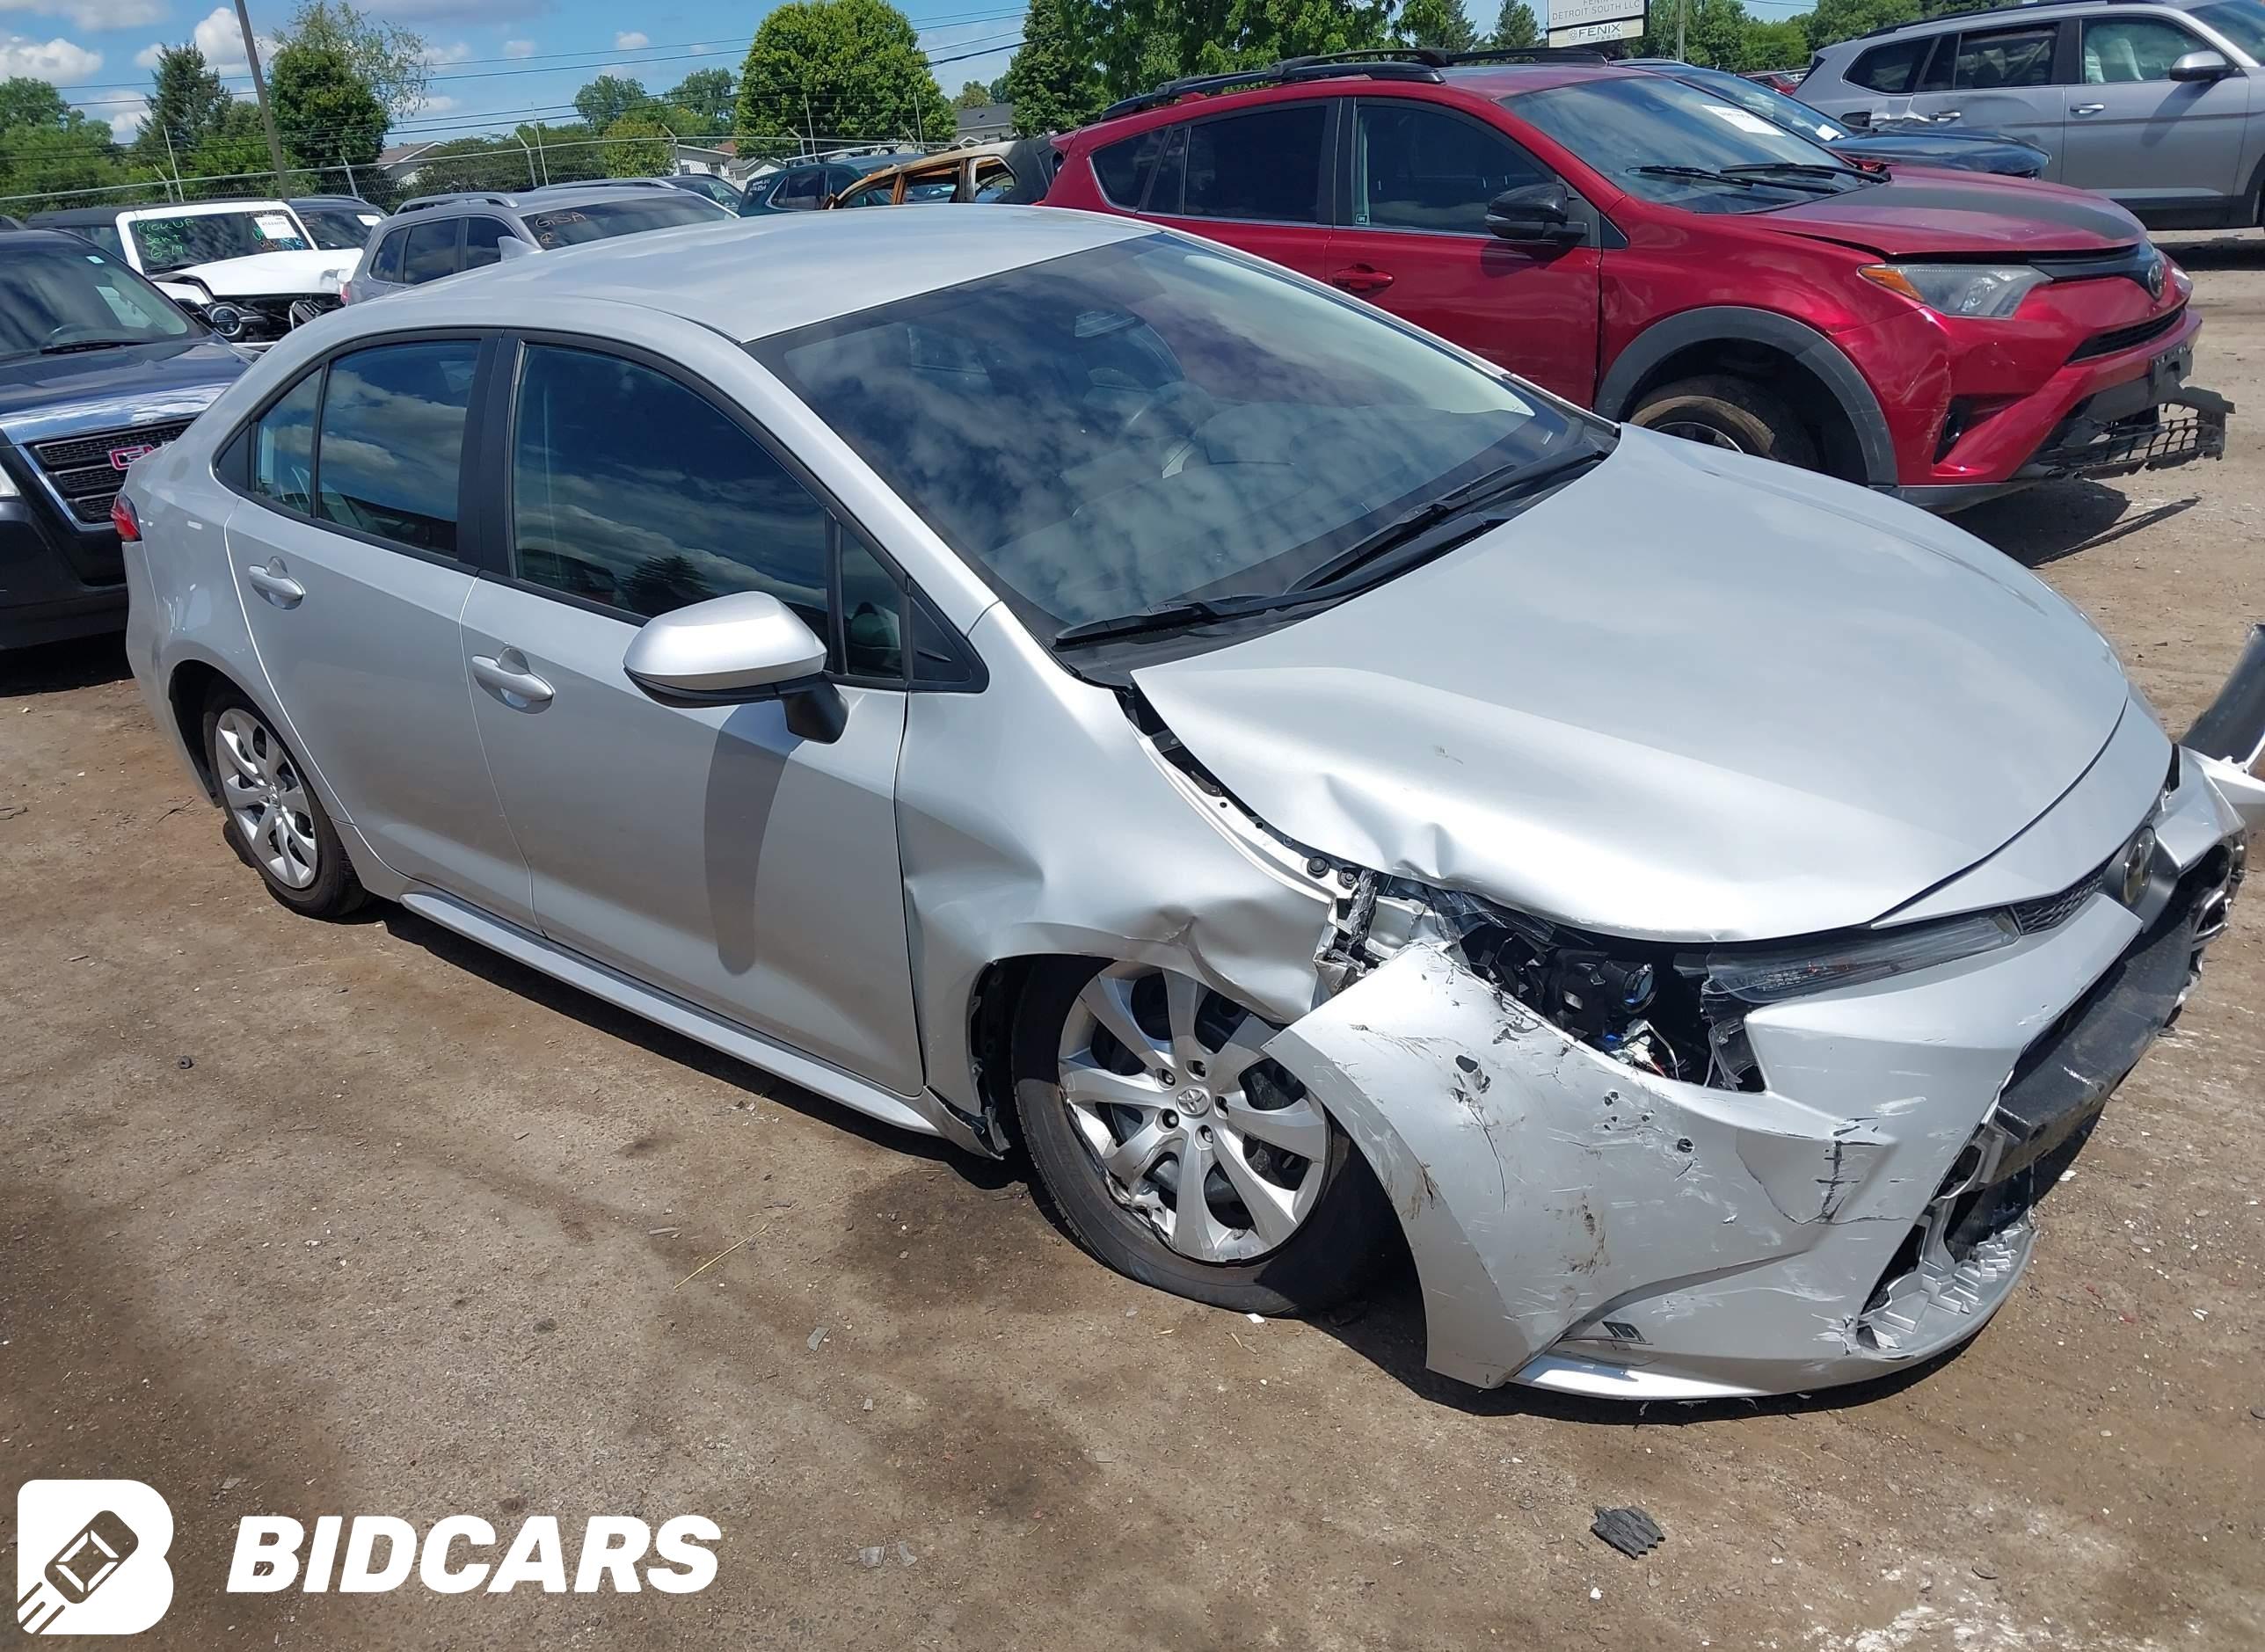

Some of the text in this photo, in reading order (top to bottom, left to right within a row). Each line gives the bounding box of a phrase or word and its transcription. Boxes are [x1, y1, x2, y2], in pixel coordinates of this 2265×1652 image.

[1552, 8, 1588, 21] DETROIT
[1591, 4, 1621, 14] SOUTH
[1624, 0, 1640, 10] LLC
[1578, 23, 1621, 38] FENIX
[150, 245, 183, 259] 6-19
